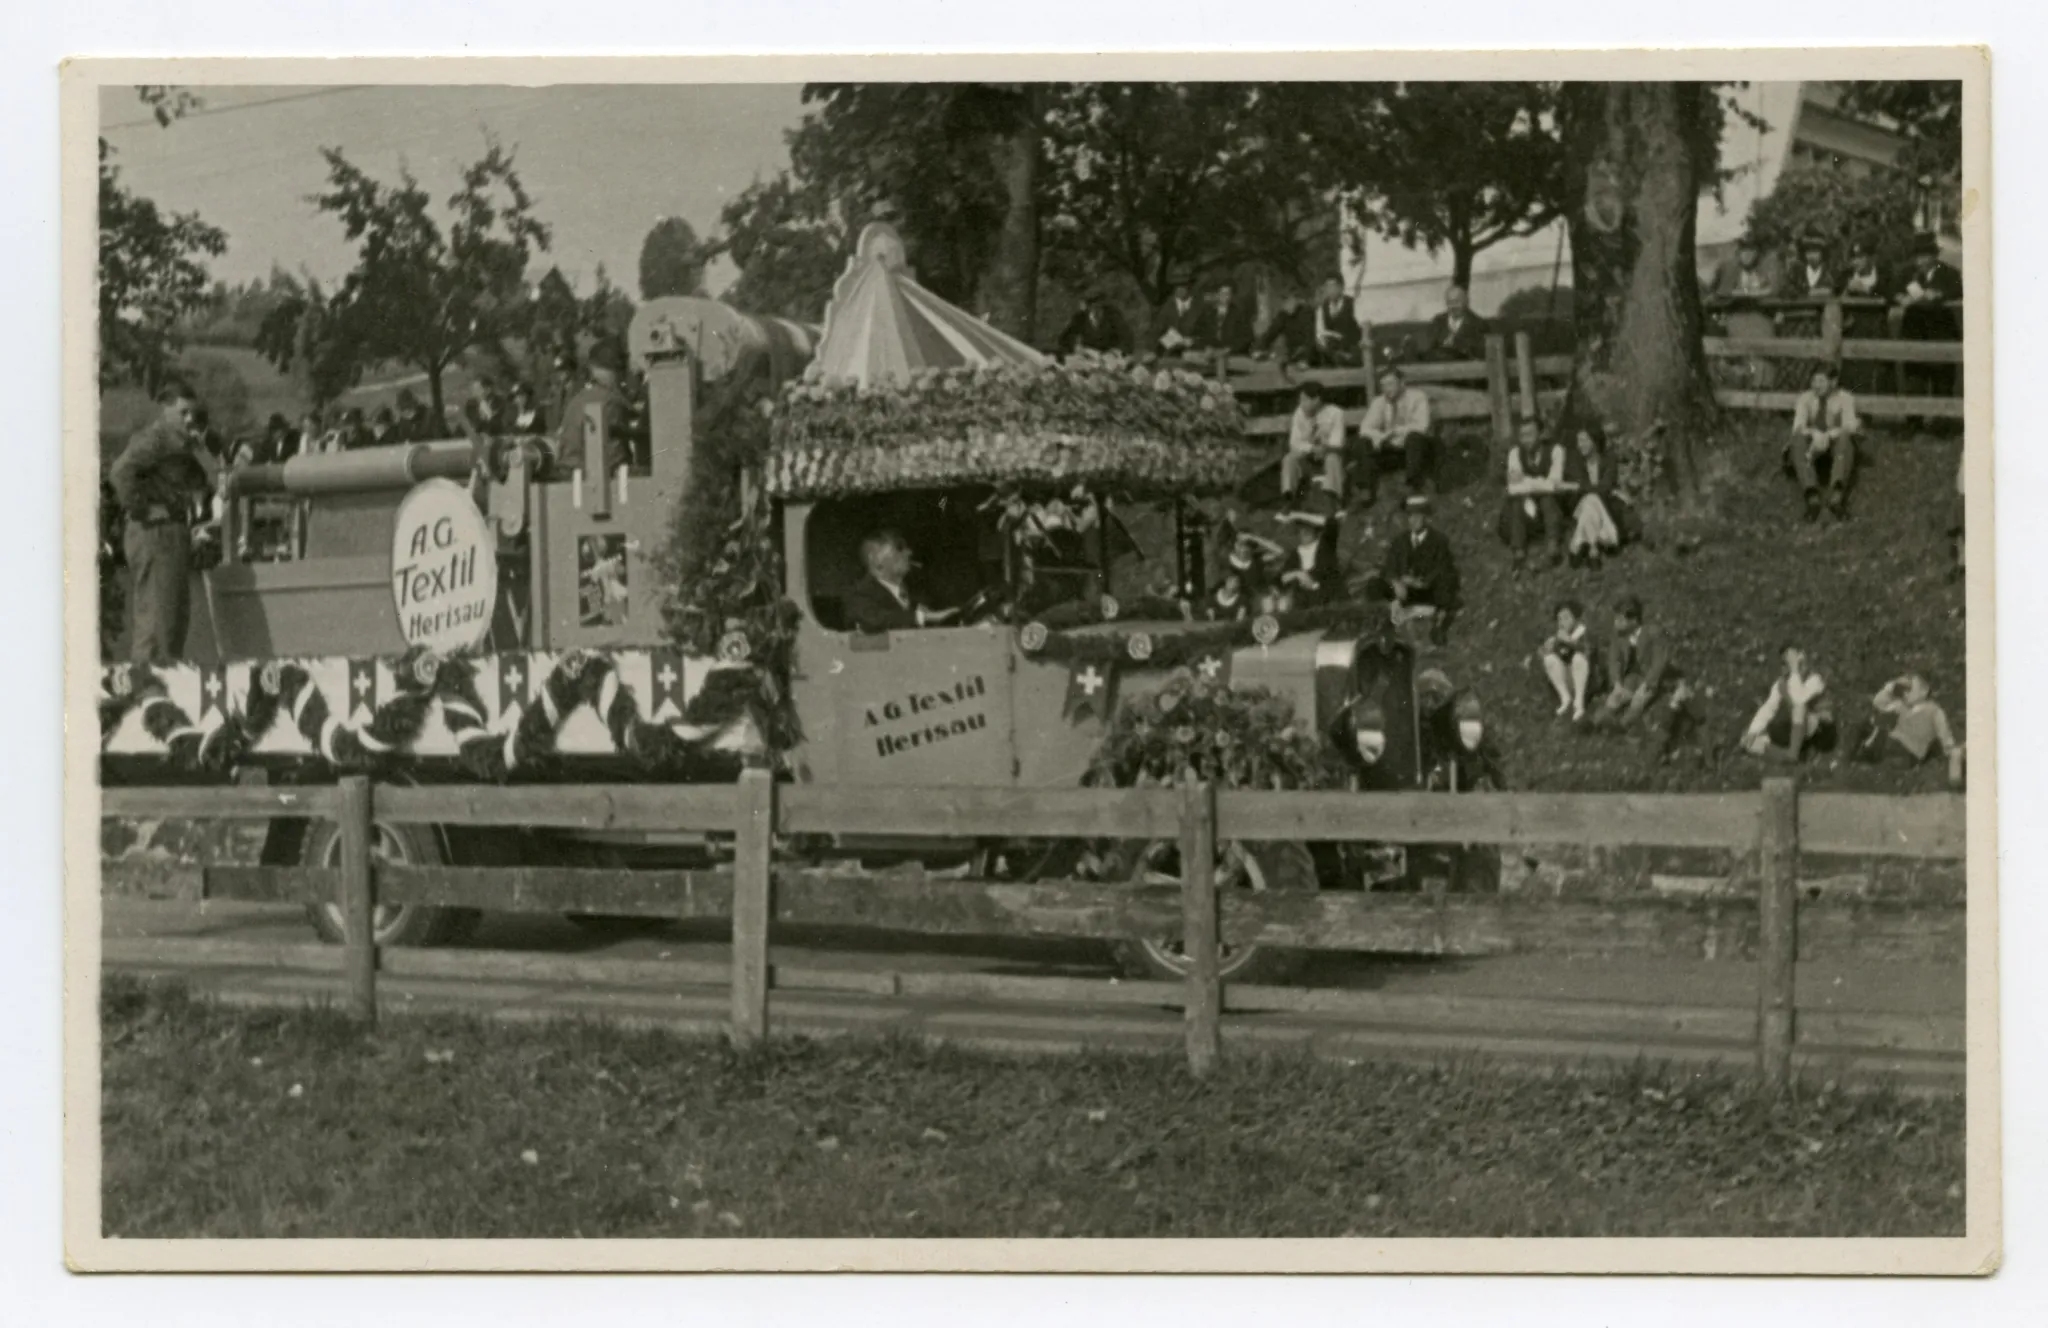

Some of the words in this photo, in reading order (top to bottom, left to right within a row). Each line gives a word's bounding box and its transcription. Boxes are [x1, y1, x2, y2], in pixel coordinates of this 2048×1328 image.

[395, 545, 476, 608] Textil
[410, 599, 486, 639] Herisau
[908, 675, 985, 714] Textil
[876, 713, 986, 757] Herisau
